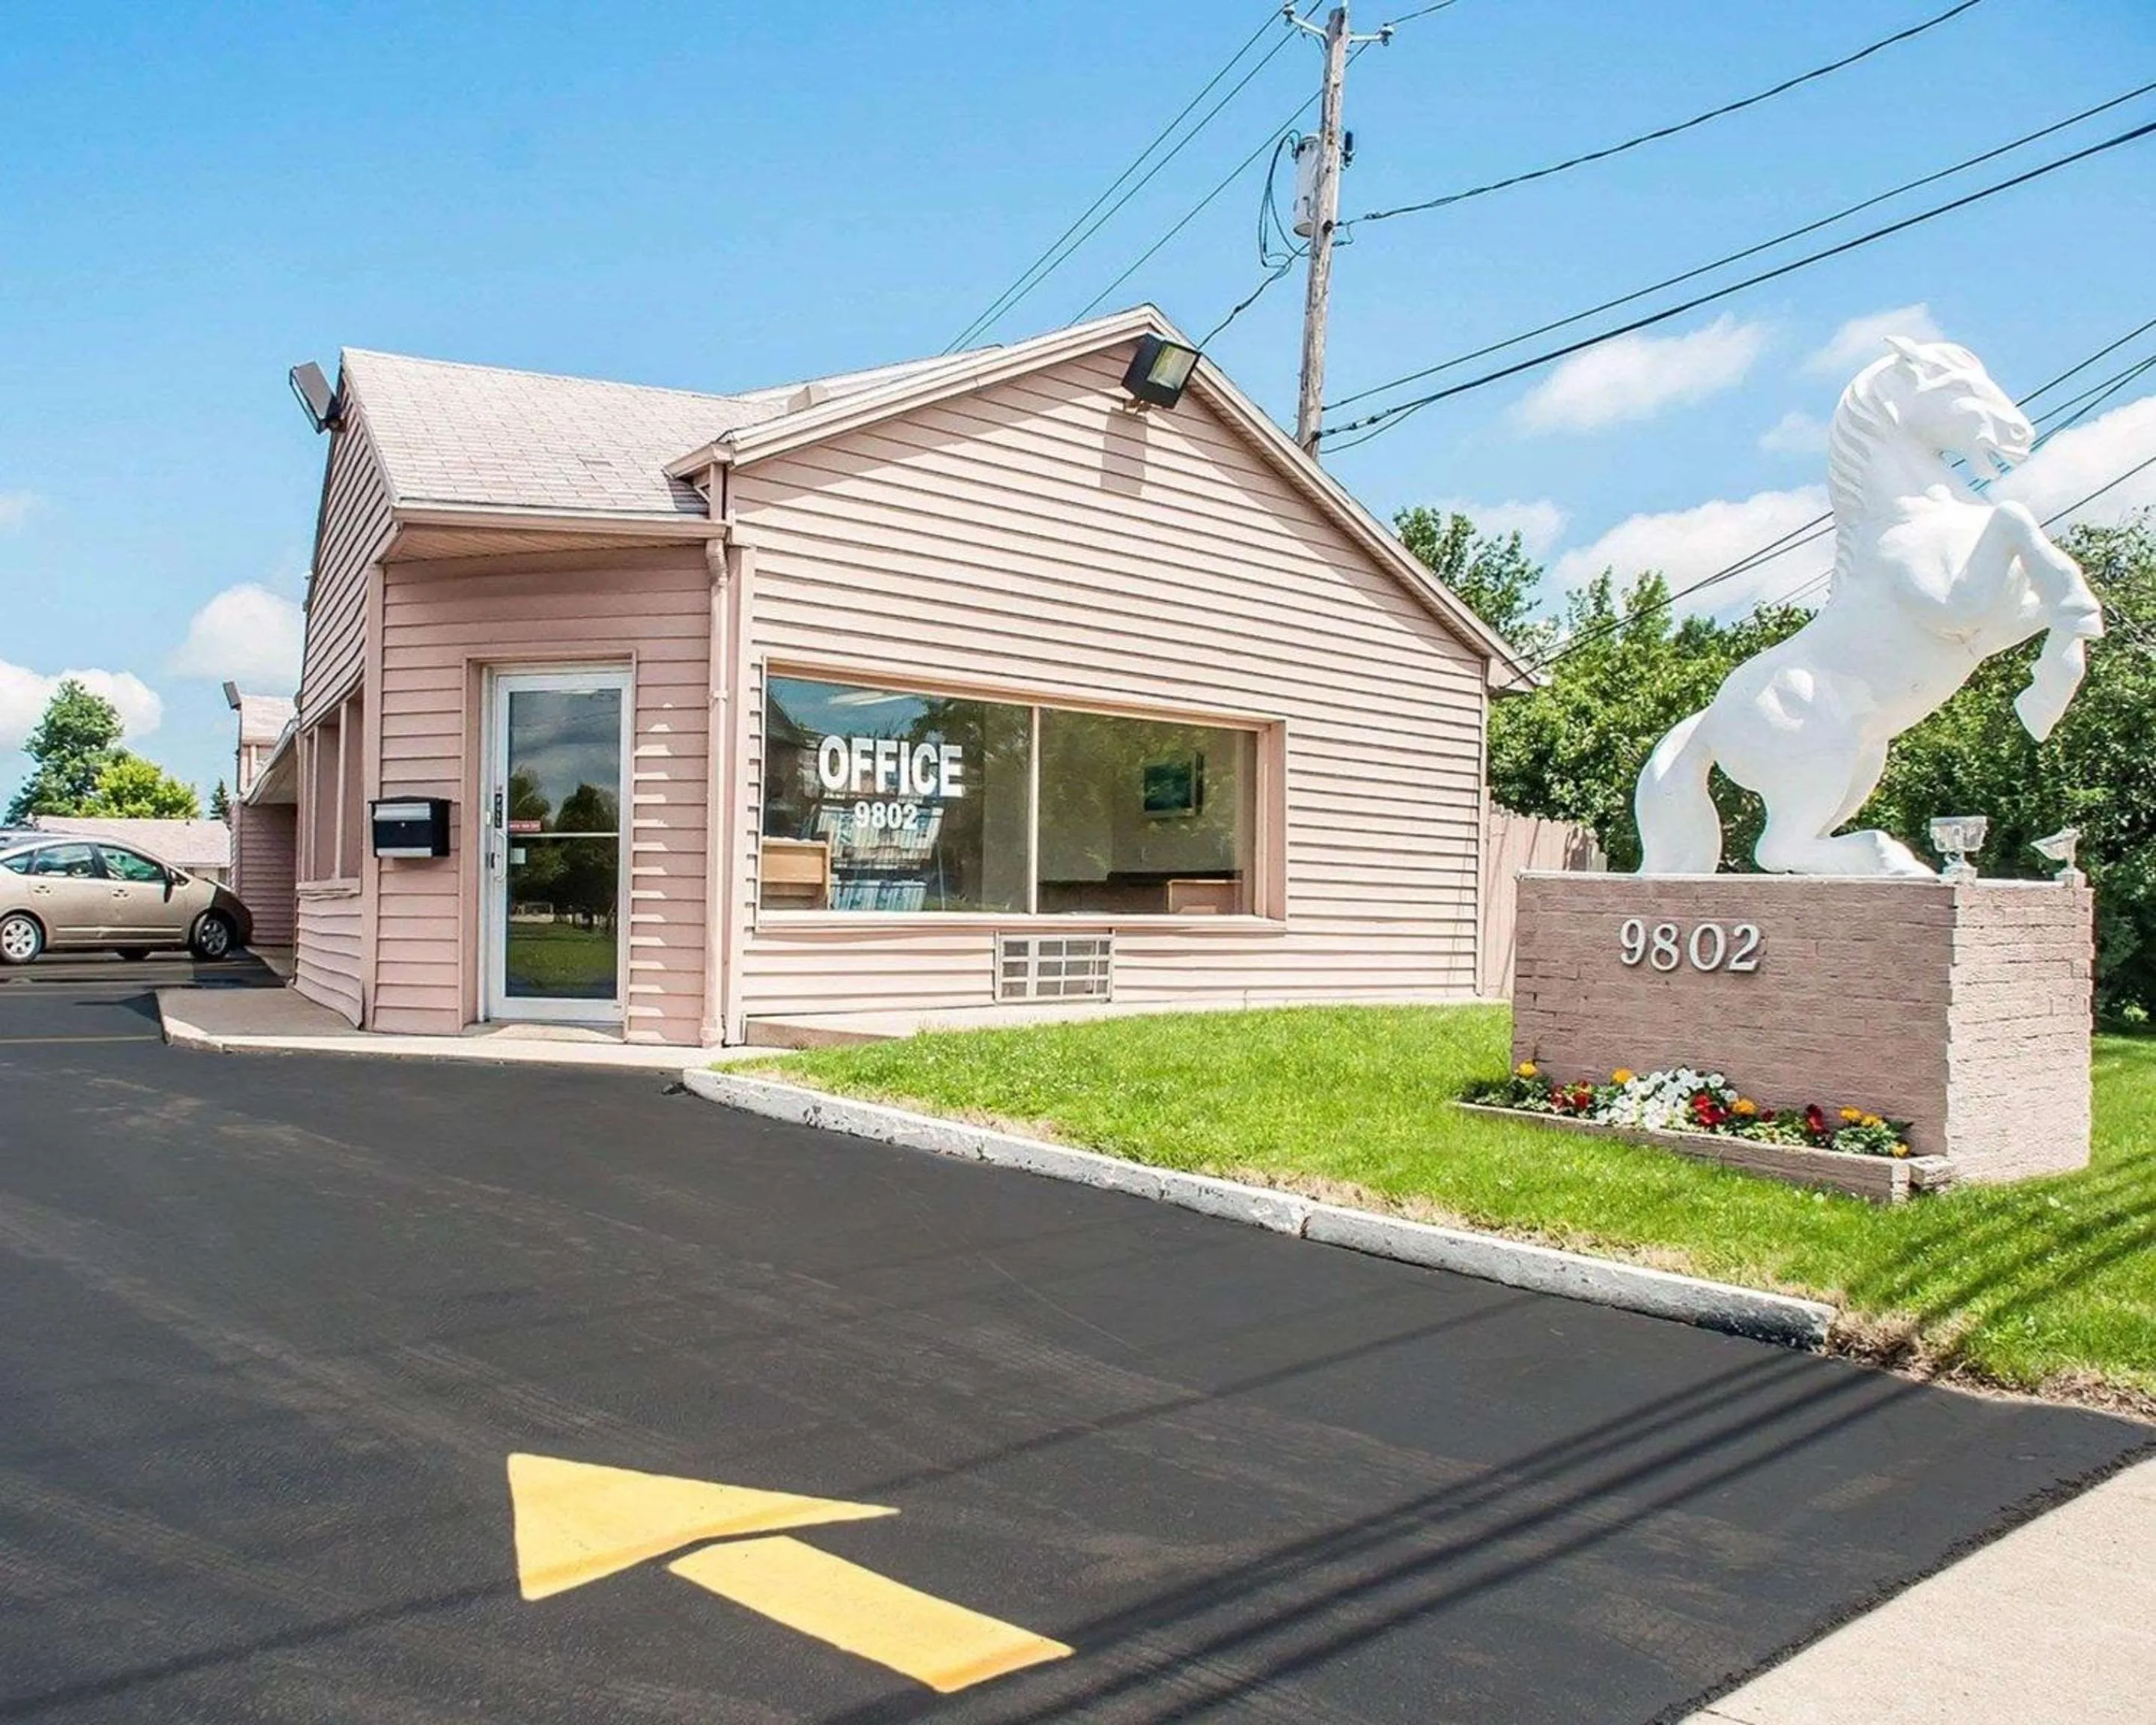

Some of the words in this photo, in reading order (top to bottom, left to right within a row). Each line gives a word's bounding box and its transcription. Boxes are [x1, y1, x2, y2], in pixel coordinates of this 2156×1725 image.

[819, 734, 963, 797] OFFICE
[854, 801, 918, 830] 9802
[1620, 919, 1760, 971] 9802
